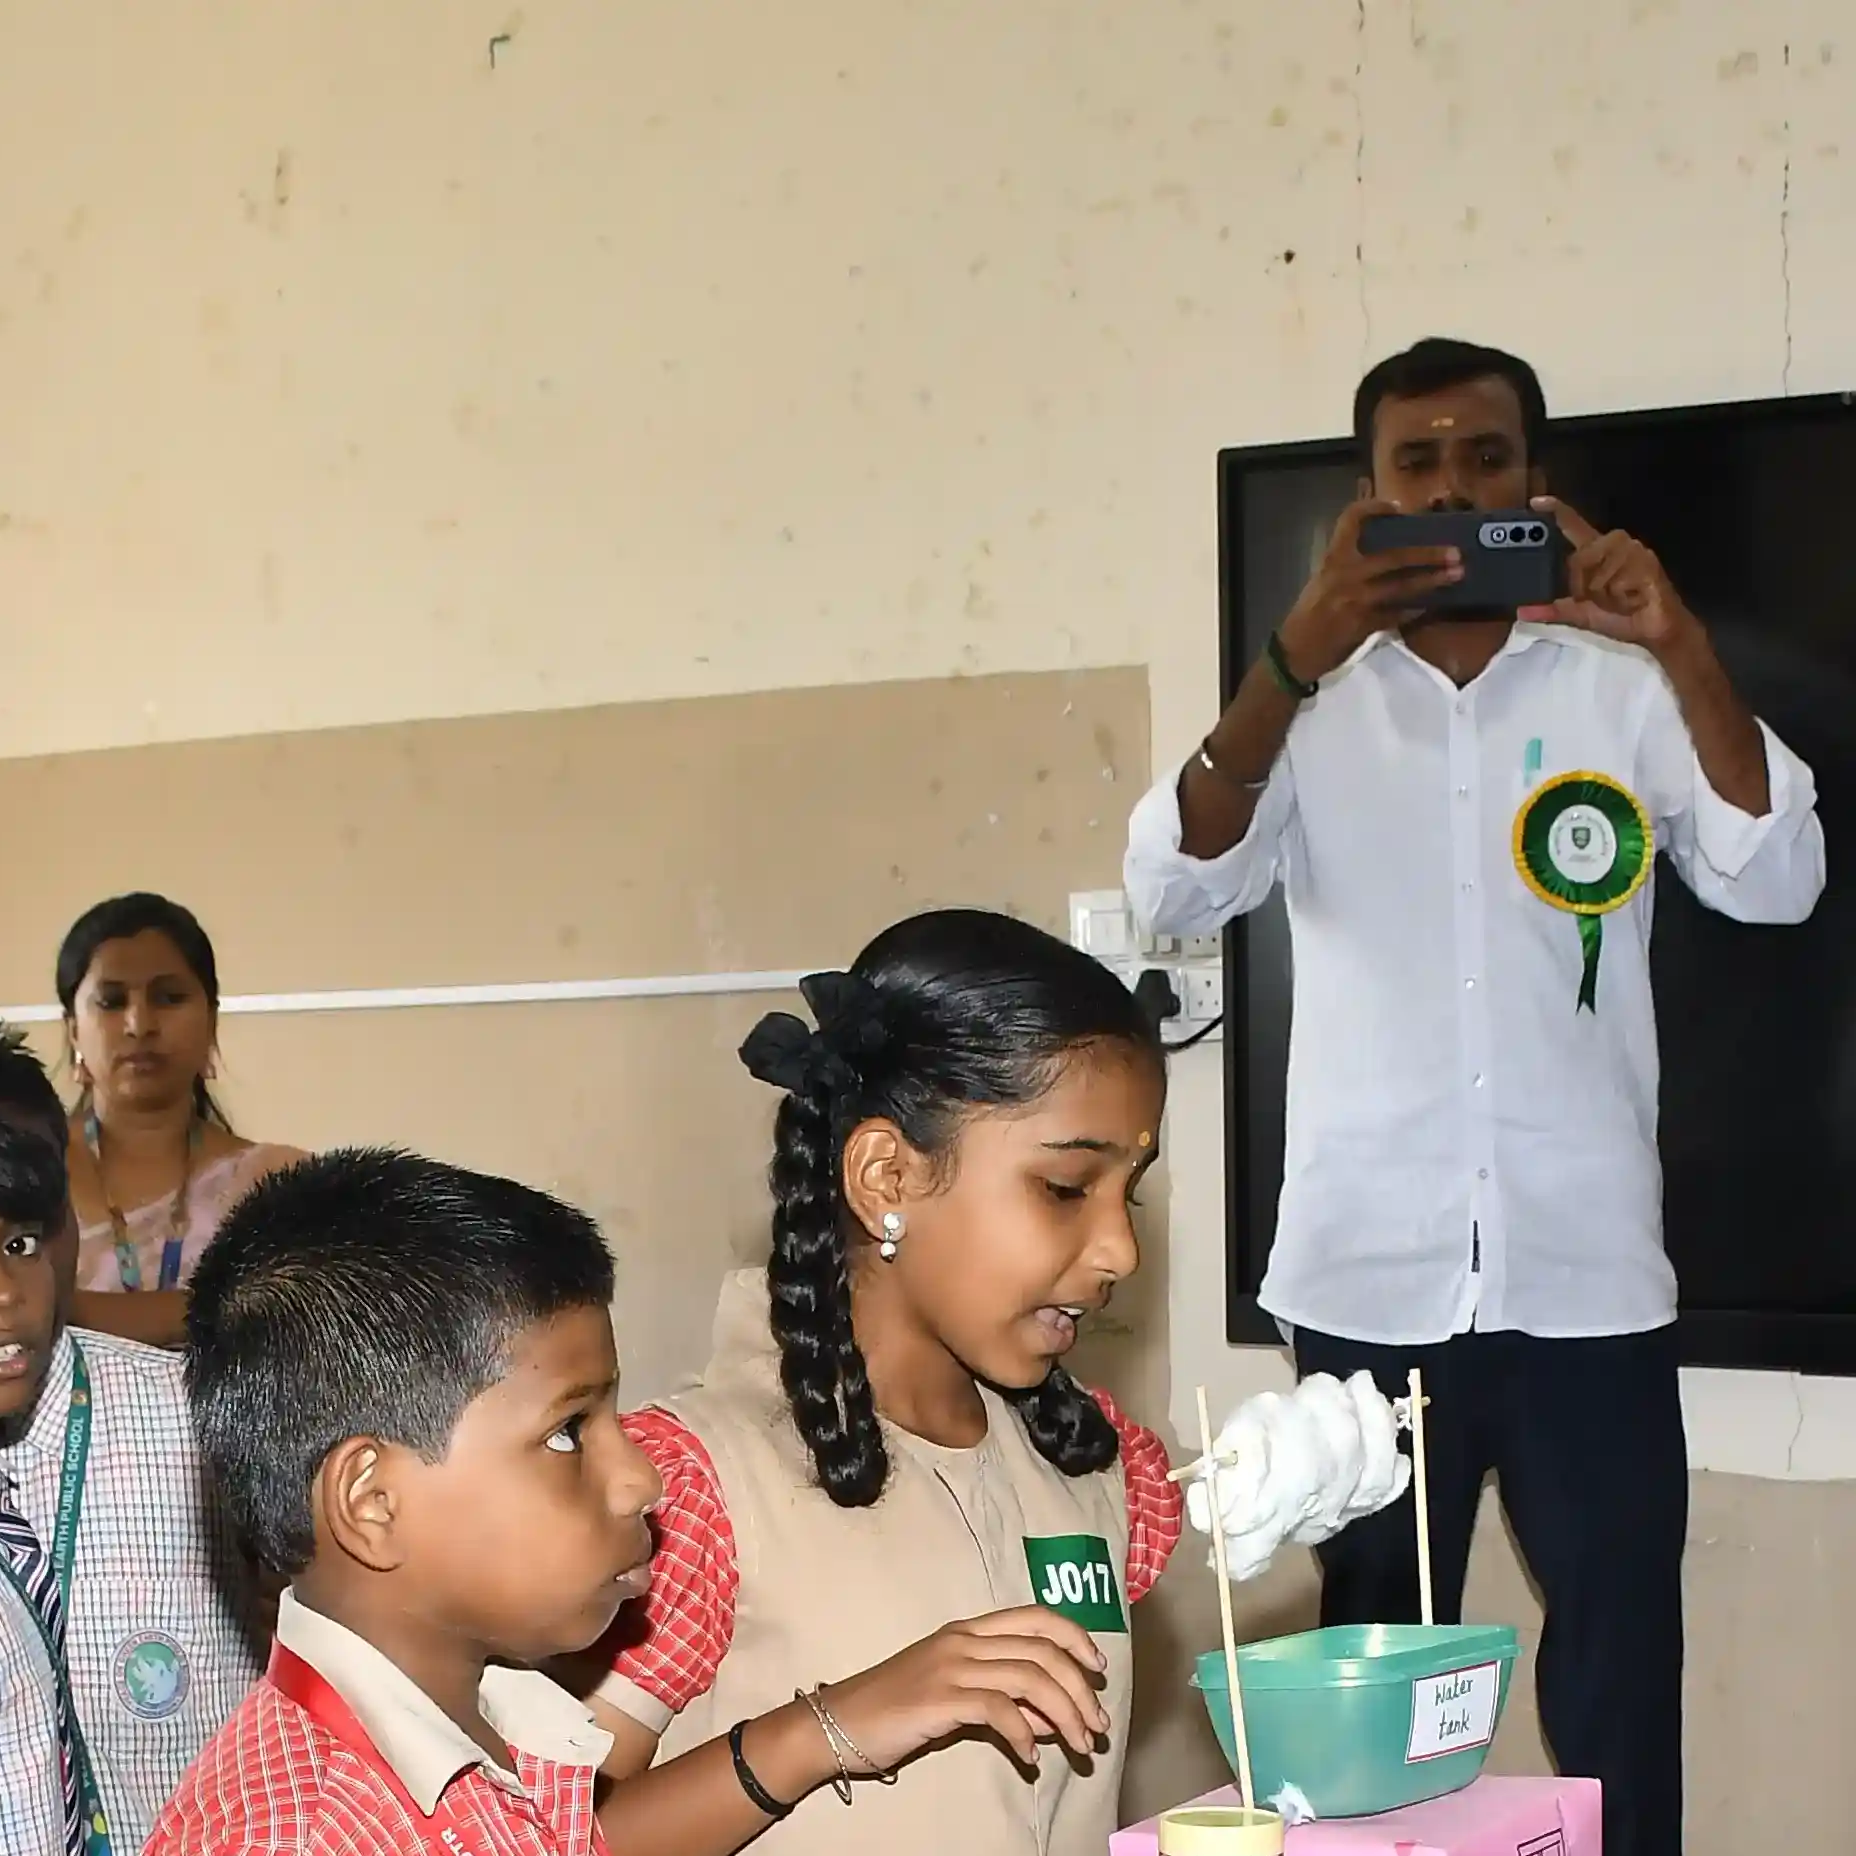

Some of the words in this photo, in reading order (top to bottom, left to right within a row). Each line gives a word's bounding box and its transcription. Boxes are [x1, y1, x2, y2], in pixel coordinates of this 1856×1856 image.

[67, 1417, 84, 1471] SCHOOL
[60, 1474, 76, 1523] PUBLIC
[1439, 1708, 1469, 1740] tank
